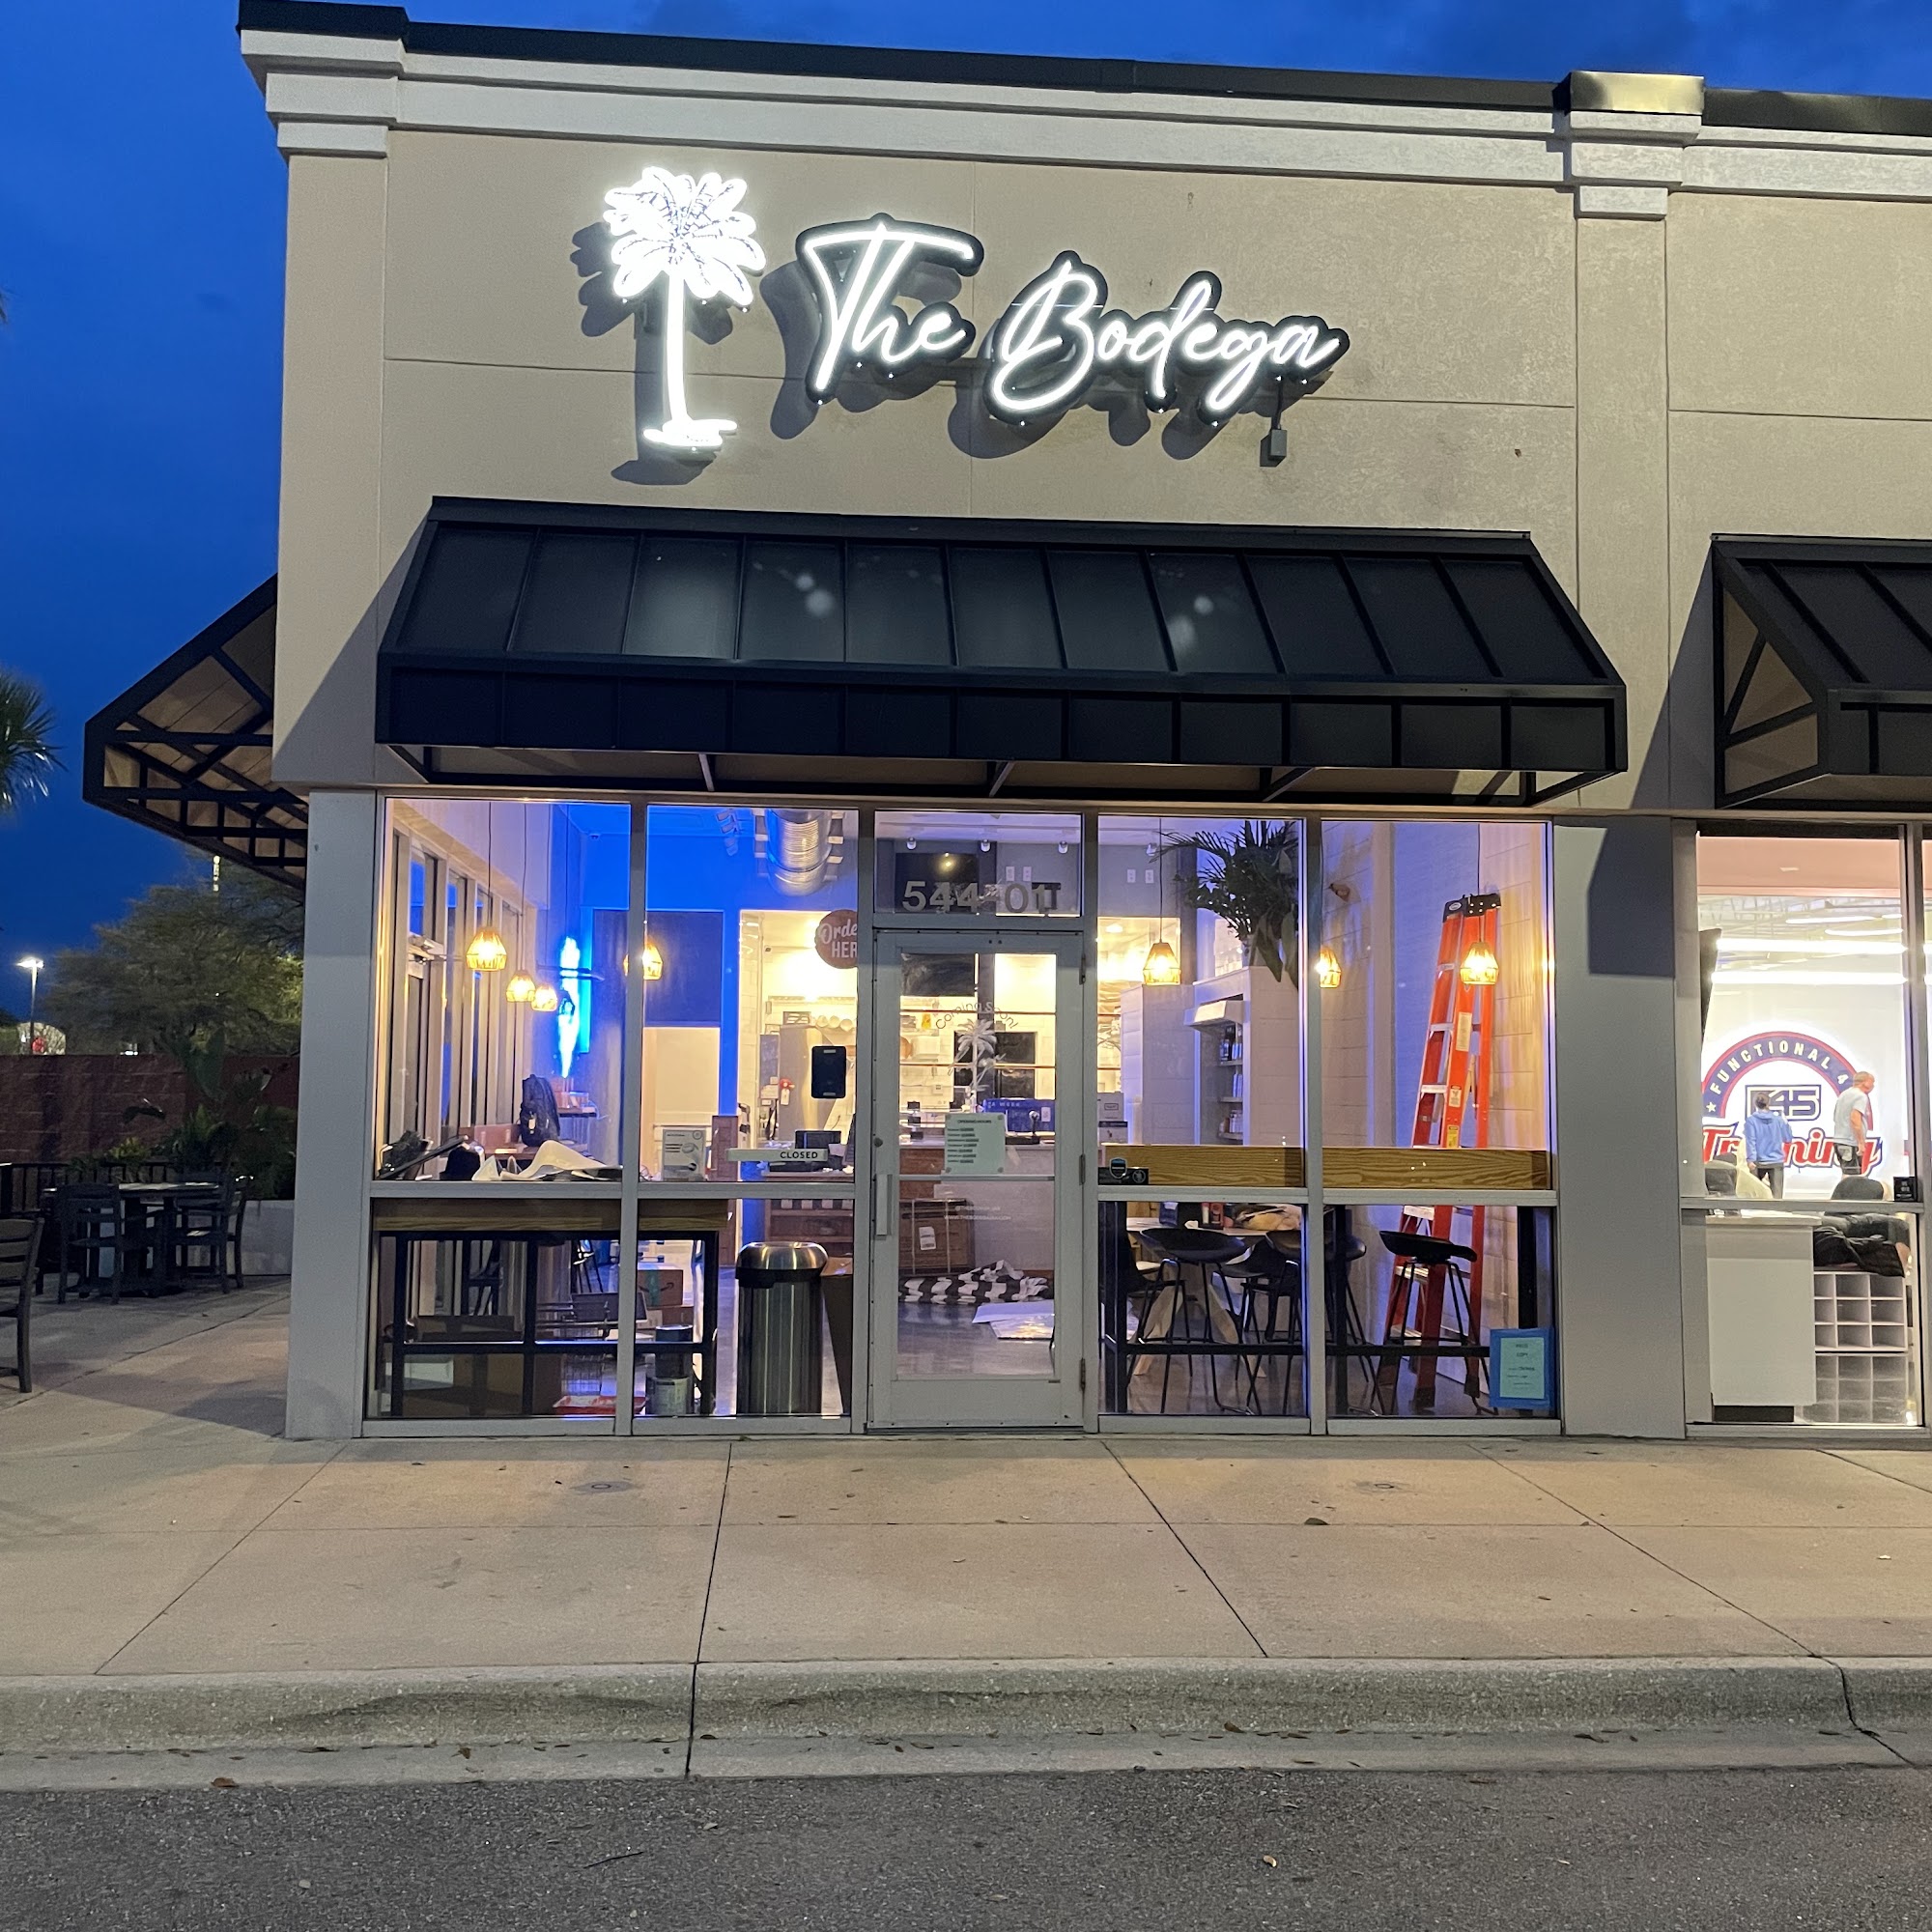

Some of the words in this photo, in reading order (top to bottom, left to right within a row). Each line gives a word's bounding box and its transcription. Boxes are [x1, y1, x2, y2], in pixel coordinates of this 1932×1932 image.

[801, 218, 977, 393] The
[988, 259, 1344, 414] Bodega
[817, 918, 858, 945] Orde
[831, 941, 858, 958] HER
[935, 1001, 982, 1030] Coming
[1709, 1039, 1832, 1096] FUNCTIONAL
[1836, 1072, 1851, 1086] 4
[780, 1151, 818, 1160] CLOSED
